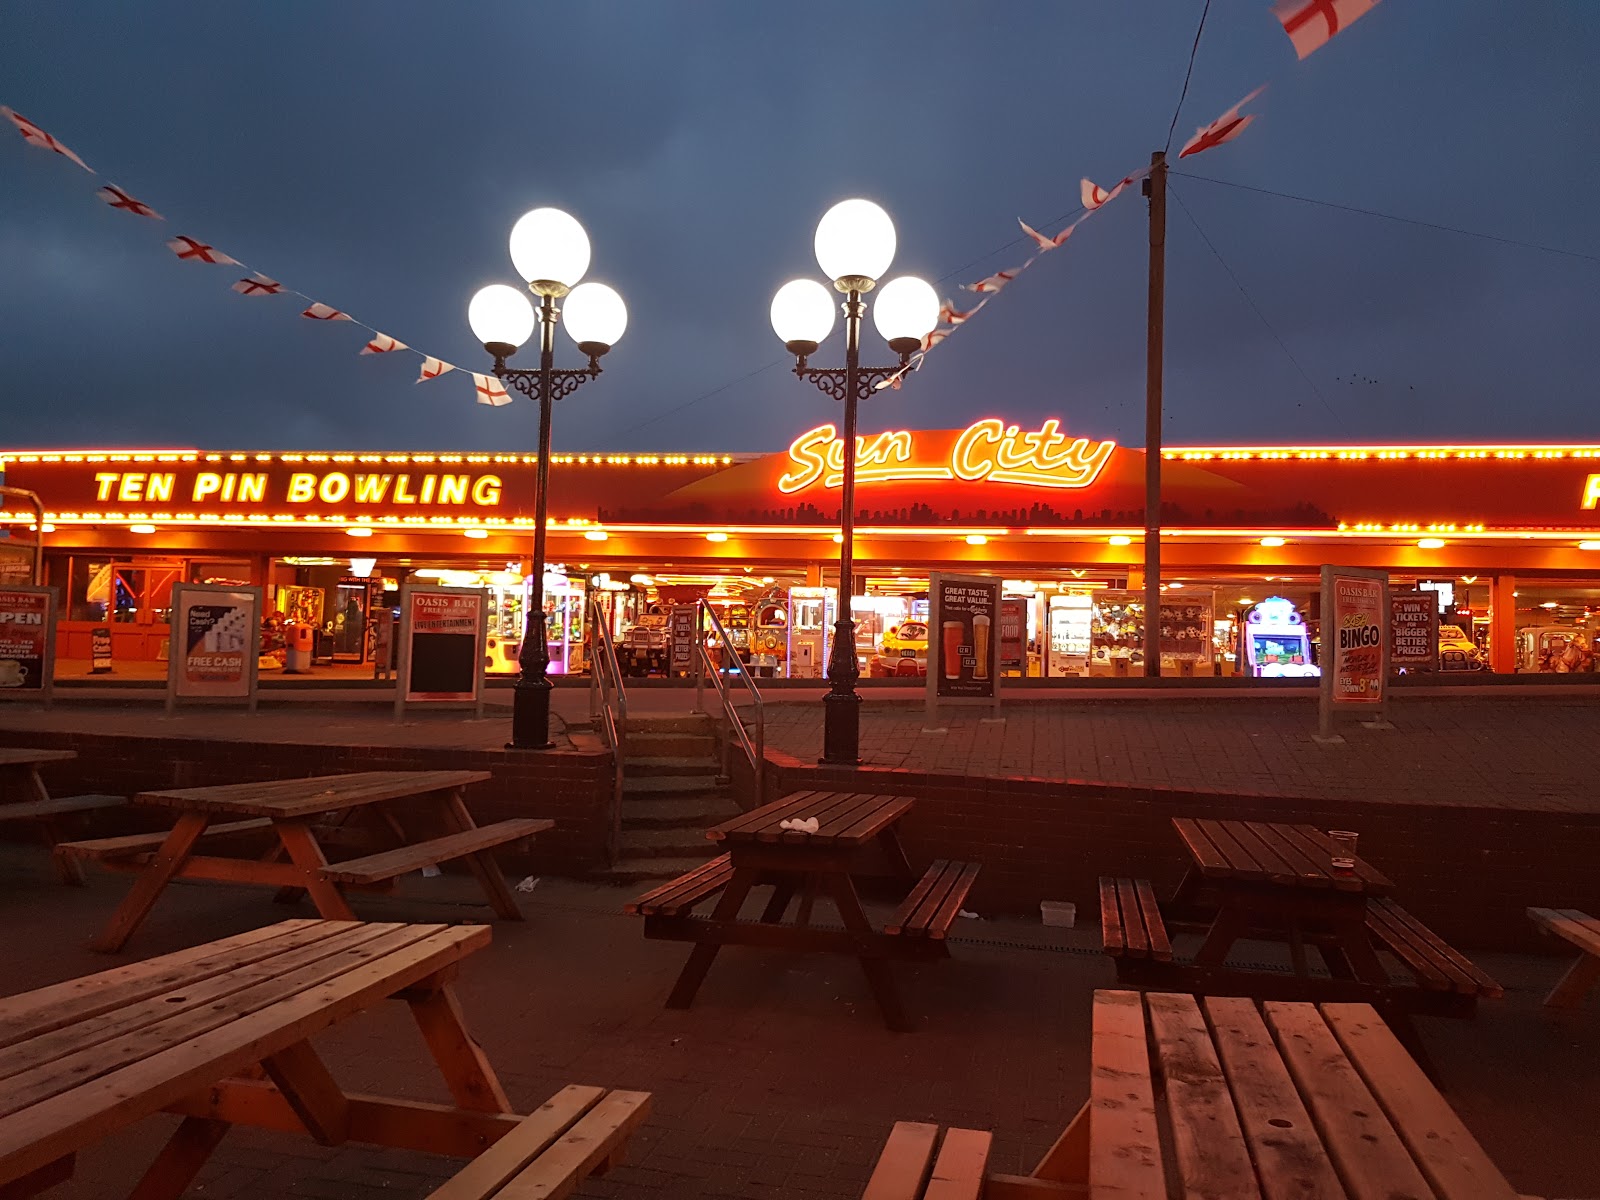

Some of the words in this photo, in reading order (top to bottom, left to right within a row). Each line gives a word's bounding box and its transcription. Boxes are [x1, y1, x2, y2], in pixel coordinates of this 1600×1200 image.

[778, 424, 912, 493] Sun
[952, 419, 1116, 488] City
[95, 472, 176, 502] TEN
[192, 472, 269, 502] PIN
[286, 471, 503, 506] BOWLING
[944, 587, 967, 596] GREAT
[967, 589, 990, 598] TASTE,
[1340, 586, 1362, 597] OASIS
[1362, 588, 1378, 598] BAR
[416, 597, 449, 607] OASIS
[454, 599, 476, 608] BAR
[944, 595, 966, 603] GREAT
[1403, 603, 1421, 613] WIN
[189, 610, 211, 618] Need
[1394, 612, 1429, 622] TICKETS
[189, 618, 215, 626] Cash?
[1340, 625, 1380, 650] BINGO
[1395, 628, 1428, 637] BIGGER
[1395, 637, 1428, 646] BETTER
[1397, 646, 1426, 655] PRIZES
[187, 657, 212, 667] FREE
[213, 657, 242, 667] CASH
[1342, 684, 1360, 693] DOWN
